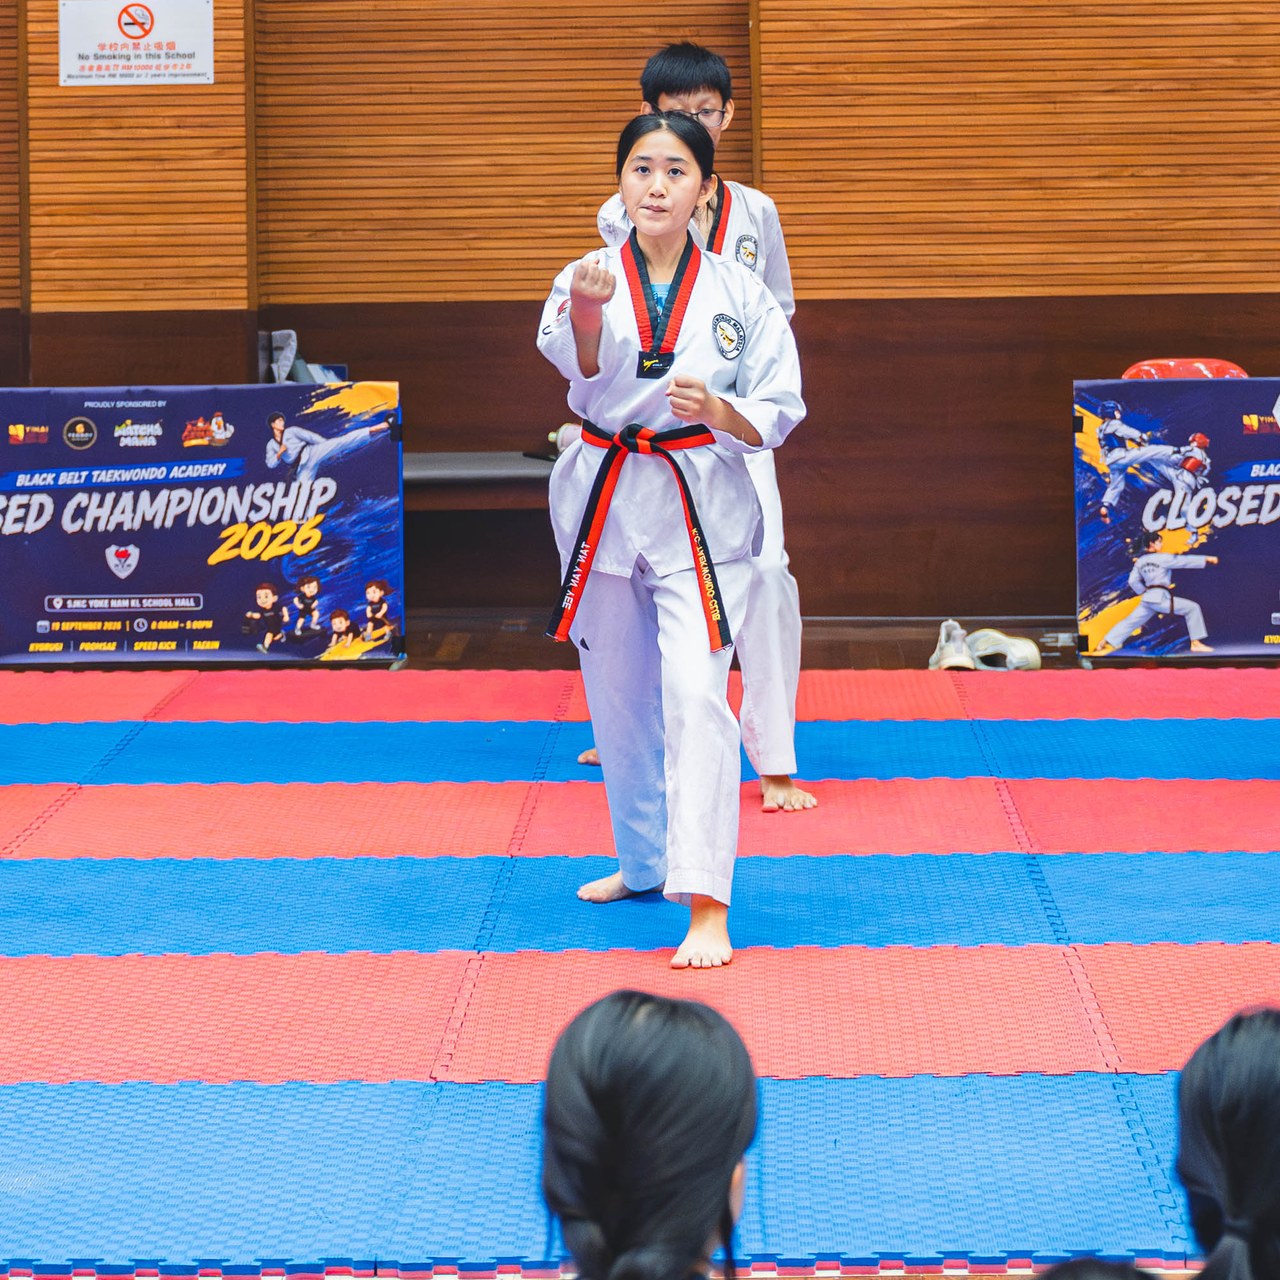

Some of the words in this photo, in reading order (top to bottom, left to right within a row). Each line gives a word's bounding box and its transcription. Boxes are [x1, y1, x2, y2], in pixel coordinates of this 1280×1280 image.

[78, 53, 90, 61] No
[93, 53, 131, 62] Smoking
[145, 52, 162, 60] this
[165, 51, 196, 60] School
[84, 401, 115, 409] PROUDLY
[116, 401, 156, 409] SPONSORED
[16, 473, 54, 487] BLACK
[57, 471, 89, 485] BELT
[91, 467, 167, 484] TAEKWONDO
[169, 463, 227, 478] ACADEMY
[62, 477, 338, 534] CHAMPIONSHIP
[207, 513, 324, 566] 2026
[142, 598, 174, 608] SCHOOL
[174, 597, 196, 607] HALL
[133, 641, 158, 651] SPEED
